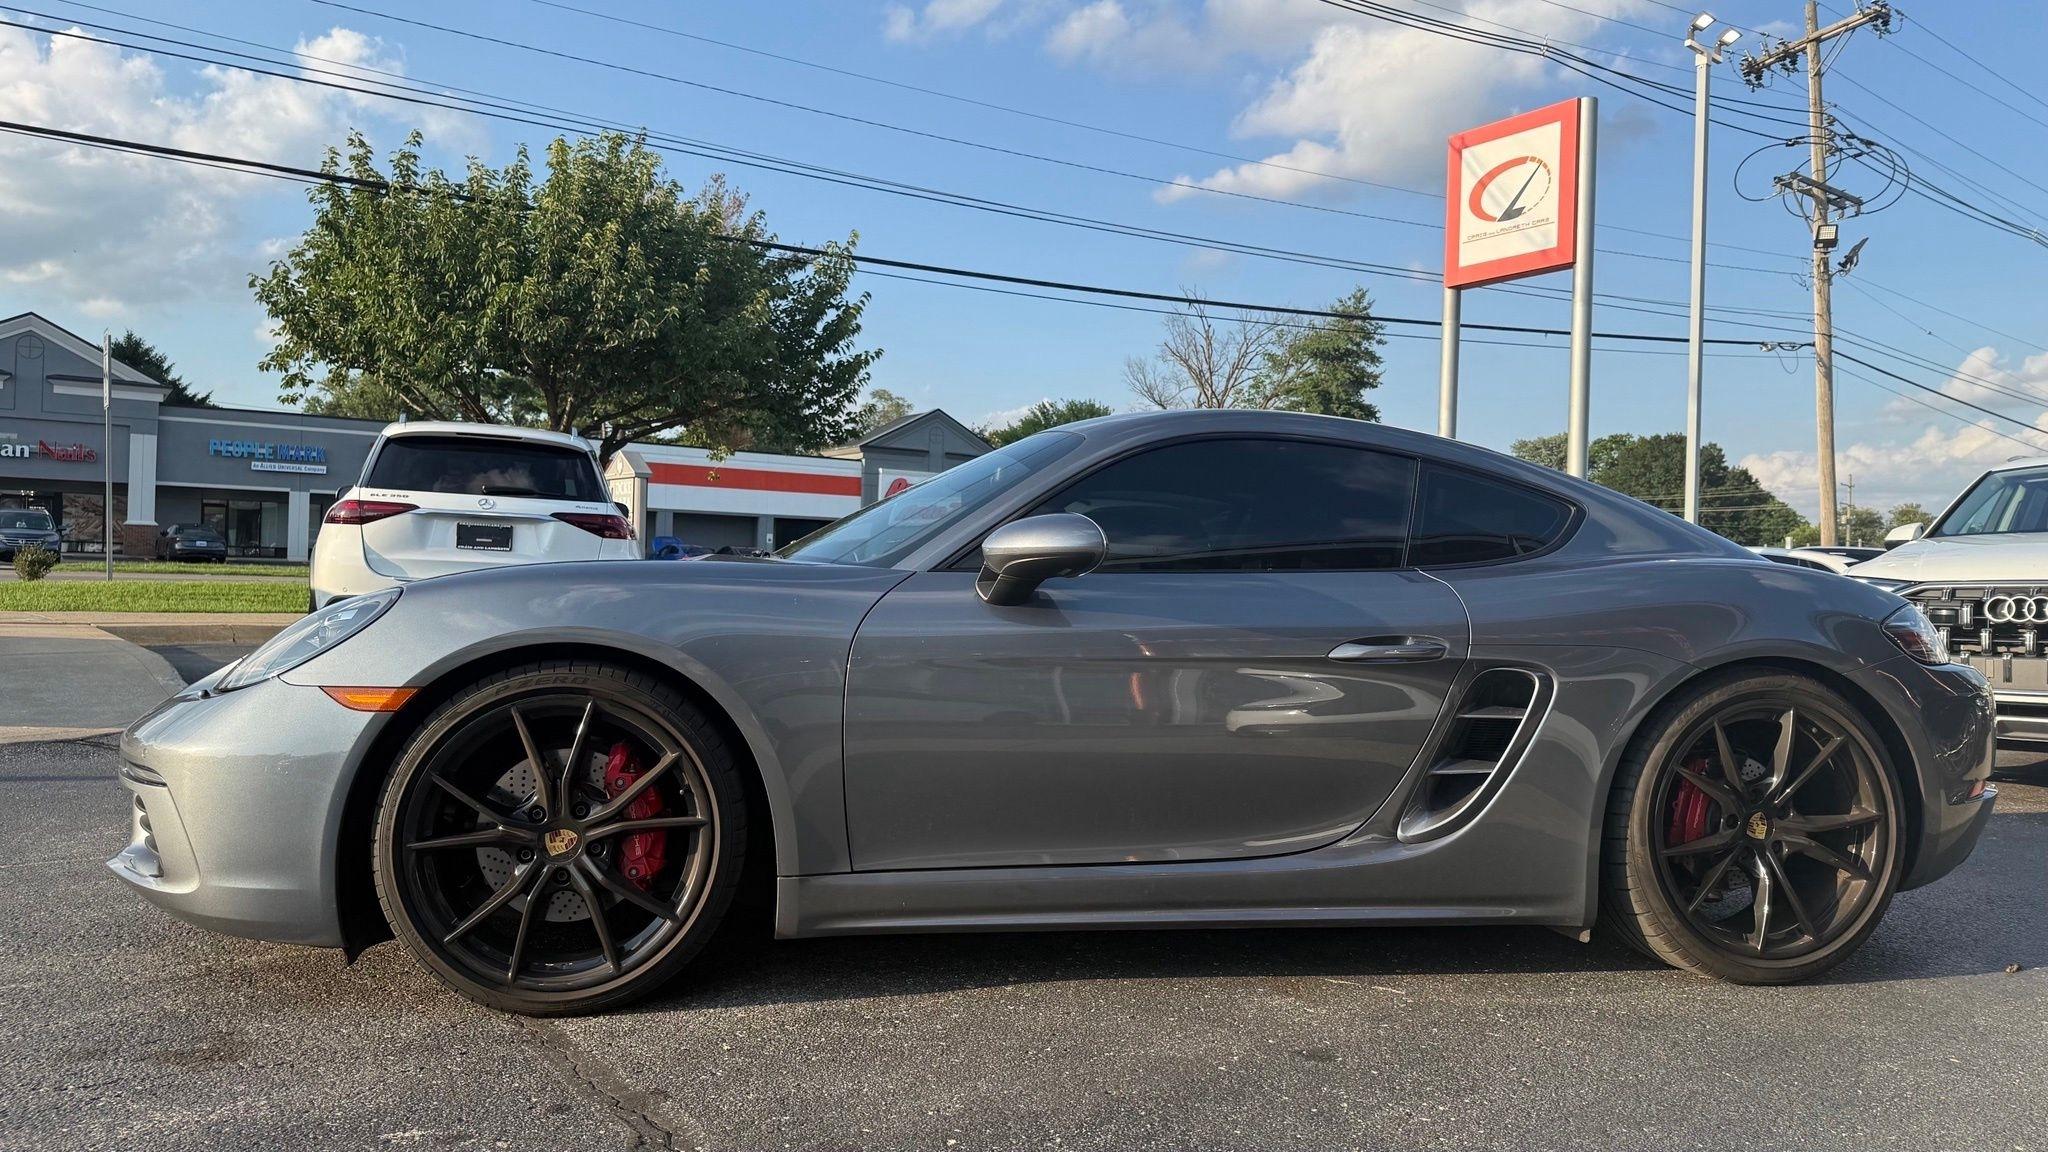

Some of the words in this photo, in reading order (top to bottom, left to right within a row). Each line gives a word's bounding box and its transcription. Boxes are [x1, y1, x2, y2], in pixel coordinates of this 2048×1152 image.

[38, 439, 96, 461] Nails
[209, 439, 273, 460] PEOPLE
[277, 443, 326, 462] MARK
